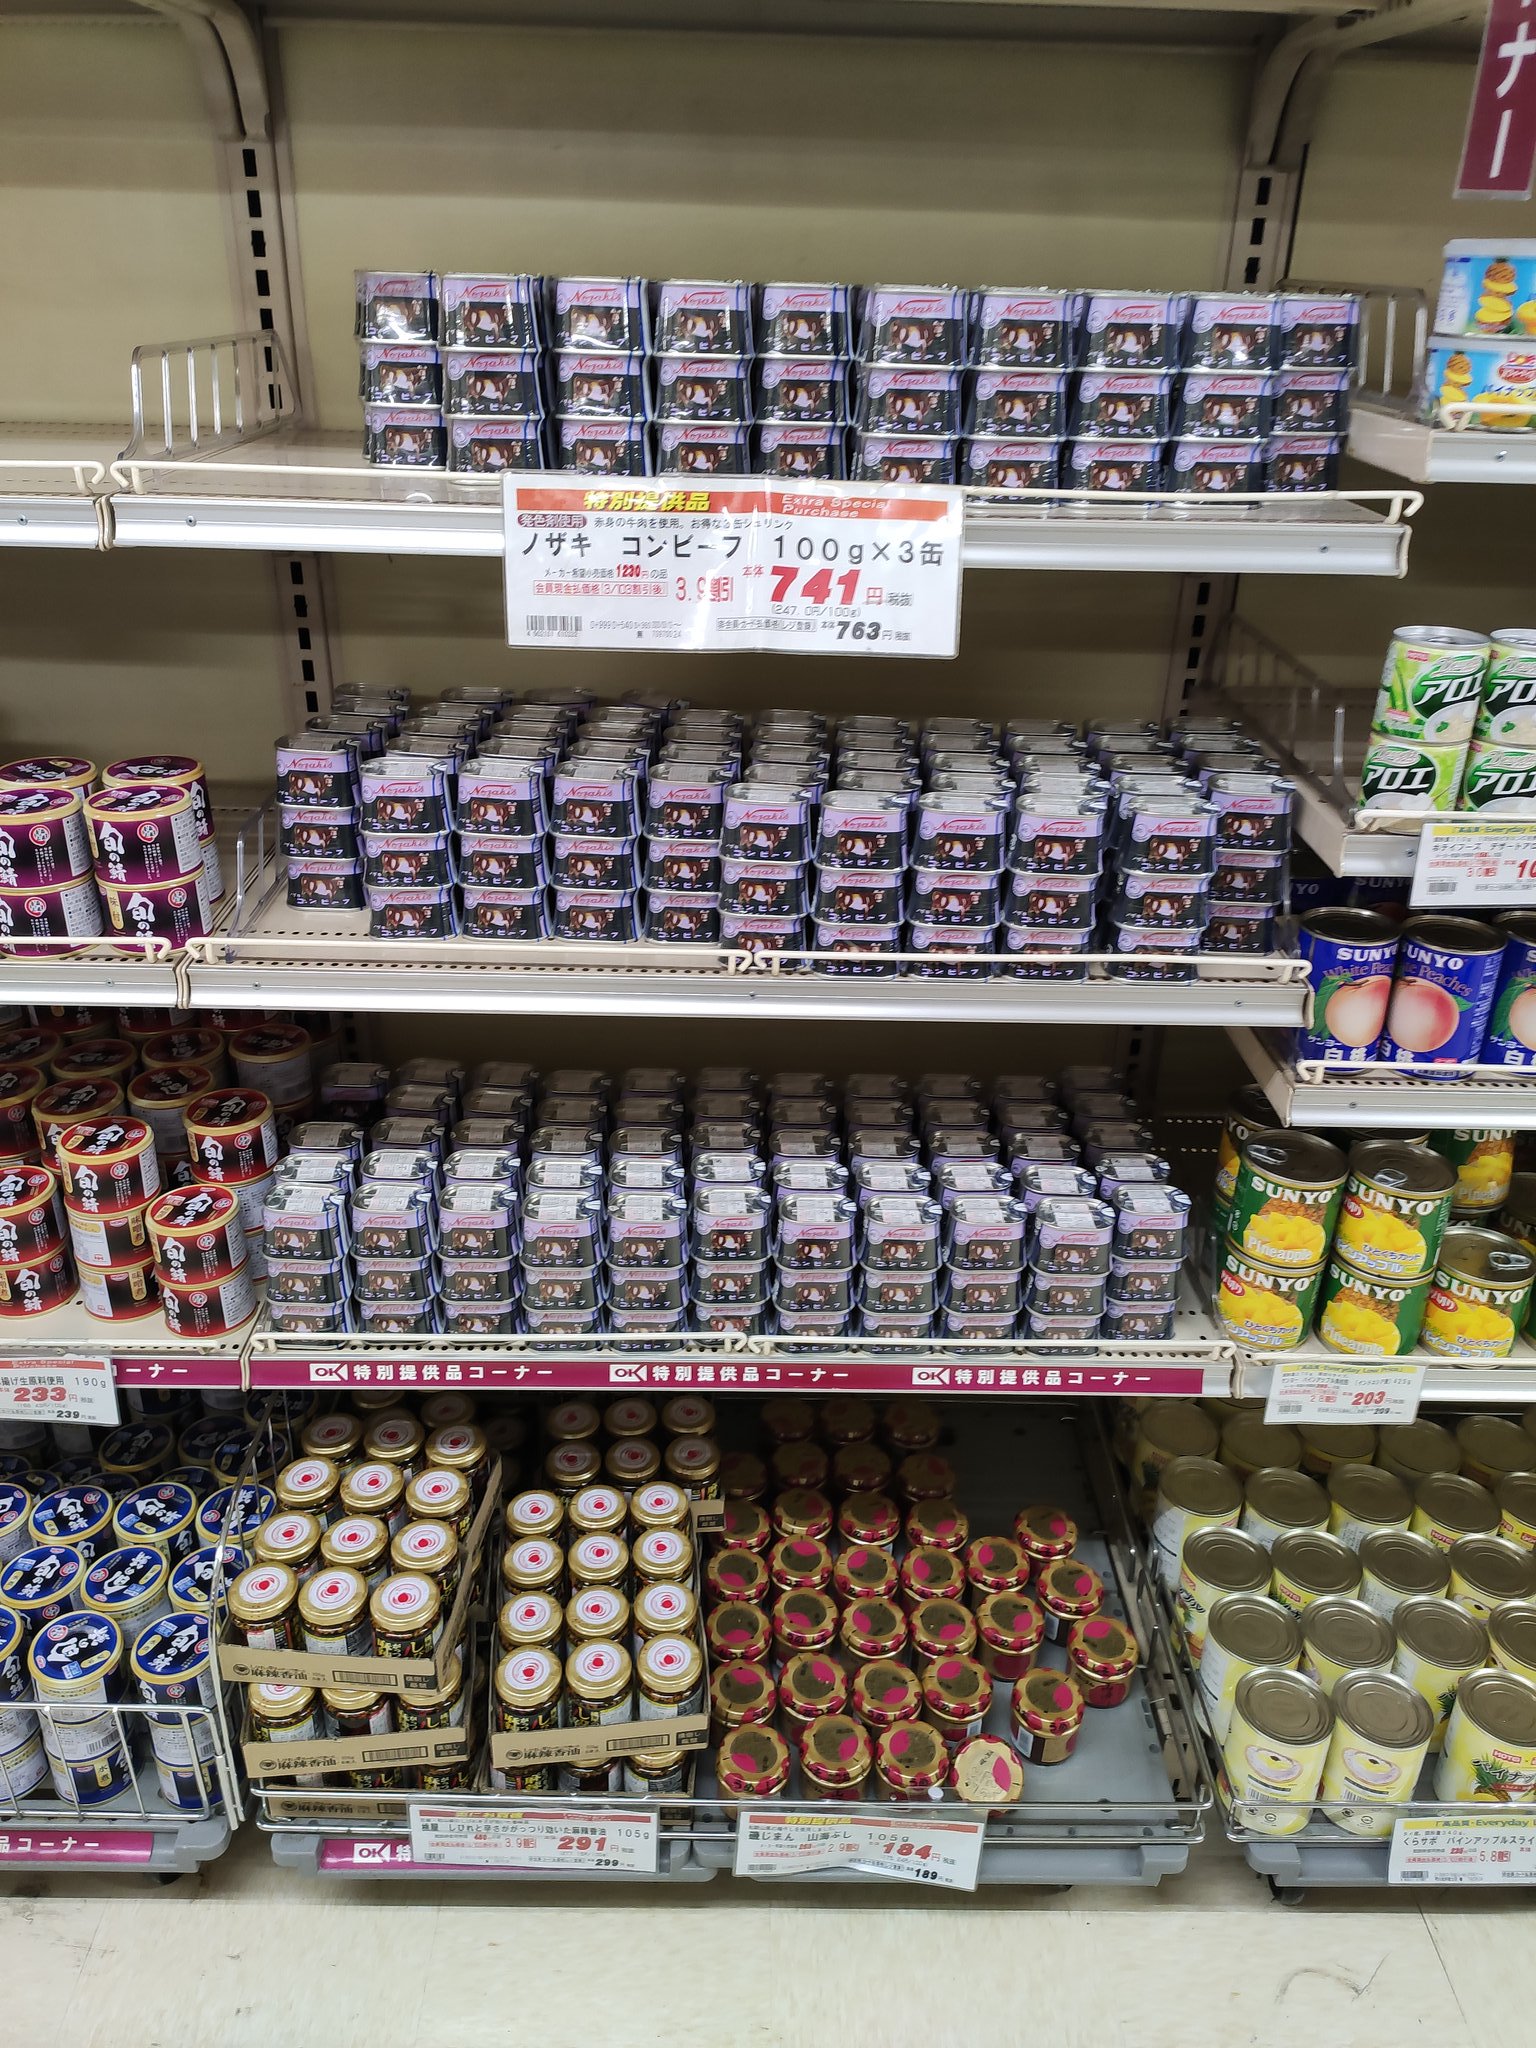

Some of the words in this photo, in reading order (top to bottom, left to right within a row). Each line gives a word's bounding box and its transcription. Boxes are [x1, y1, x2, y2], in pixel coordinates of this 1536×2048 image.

[782, 494, 825, 507] Extra
[830, 496, 889, 510] Special
[782, 505, 859, 518] Purchase
[522, 533, 592, 558] ノザキ
[623, 534, 741, 559] コンビーフ
[770, 566, 861, 604] 741
[836, 620, 882, 640] 763
[1362, 766, 1435, 790] アロエ
[1251, 1175, 1333, 1205] SUNYO
[1347, 1176, 1436, 1216] SUNYO
[1246, 1232, 1314, 1263] Pineapple
[1226, 1254, 1311, 1292] SUNYO
[1330, 1263, 1406, 1302] SUNYO
[1434, 1270, 1526, 1305] SUNYO
[112, 1363, 188, 1378] ーナー
[354, 1364, 553, 1381] 特別提供品コーナー
[652, 1365, 849, 1382] 特別提供品コーナー
[955, 1368, 1152, 1386] 特別提供品コーナー
[14, 1387, 67, 1402] 233
[1351, 1390, 1387, 1406] 203
[56, 1409, 80, 1419] 239
[617, 1828, 650, 1839] 105g
[557, 1836, 607, 1852] 291
[883, 1842, 933, 1860] 184
[594, 1858, 619, 1867] 299
[914, 1868, 938, 1880] 189
